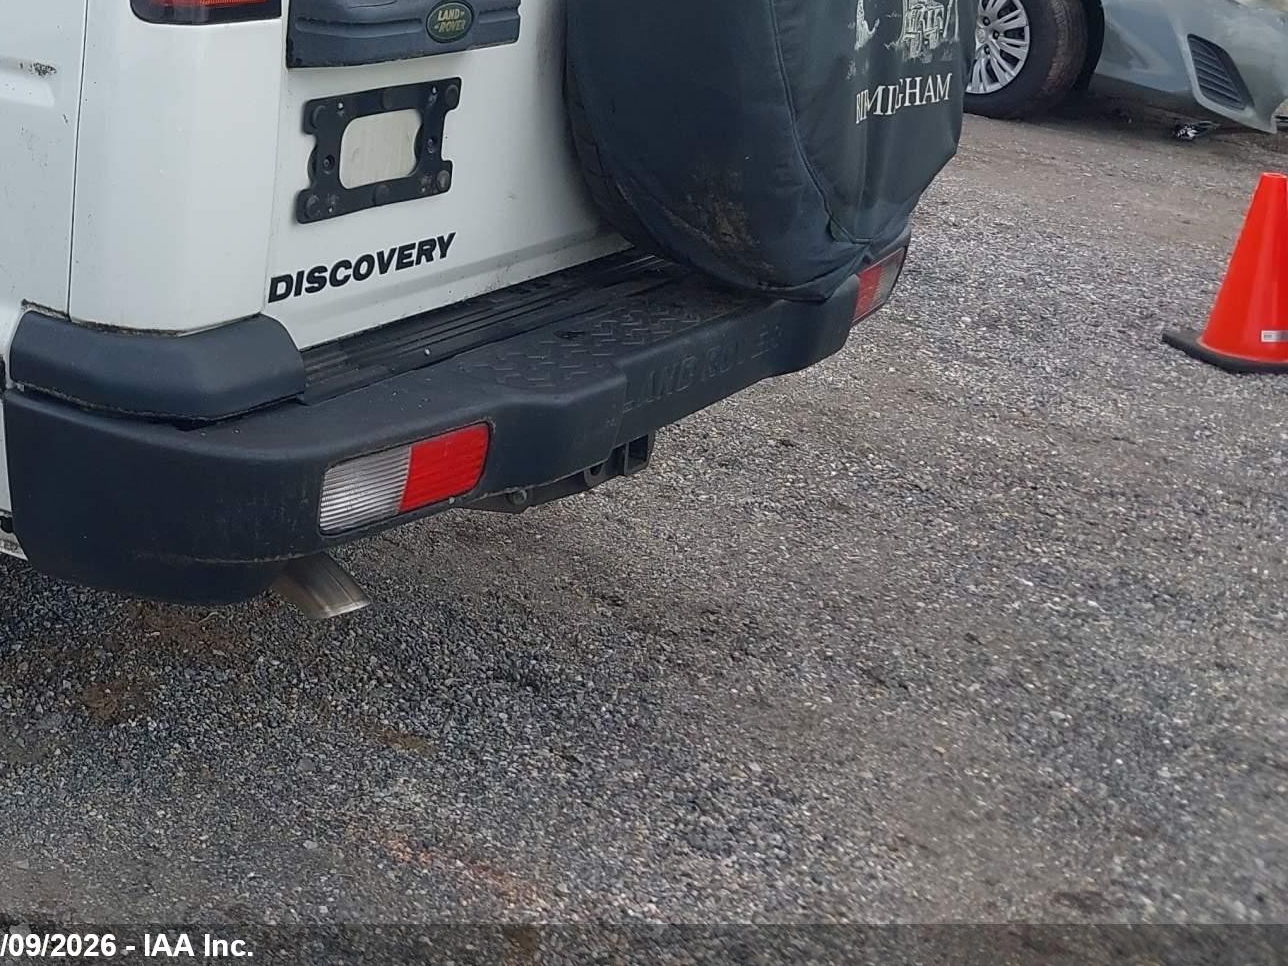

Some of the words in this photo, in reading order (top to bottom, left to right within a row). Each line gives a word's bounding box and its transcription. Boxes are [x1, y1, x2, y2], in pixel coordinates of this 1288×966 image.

[438, 8, 460, 22] LAND
[438, 19, 466, 33] ROVER
[267, 232, 457, 304] DISCOVERY
